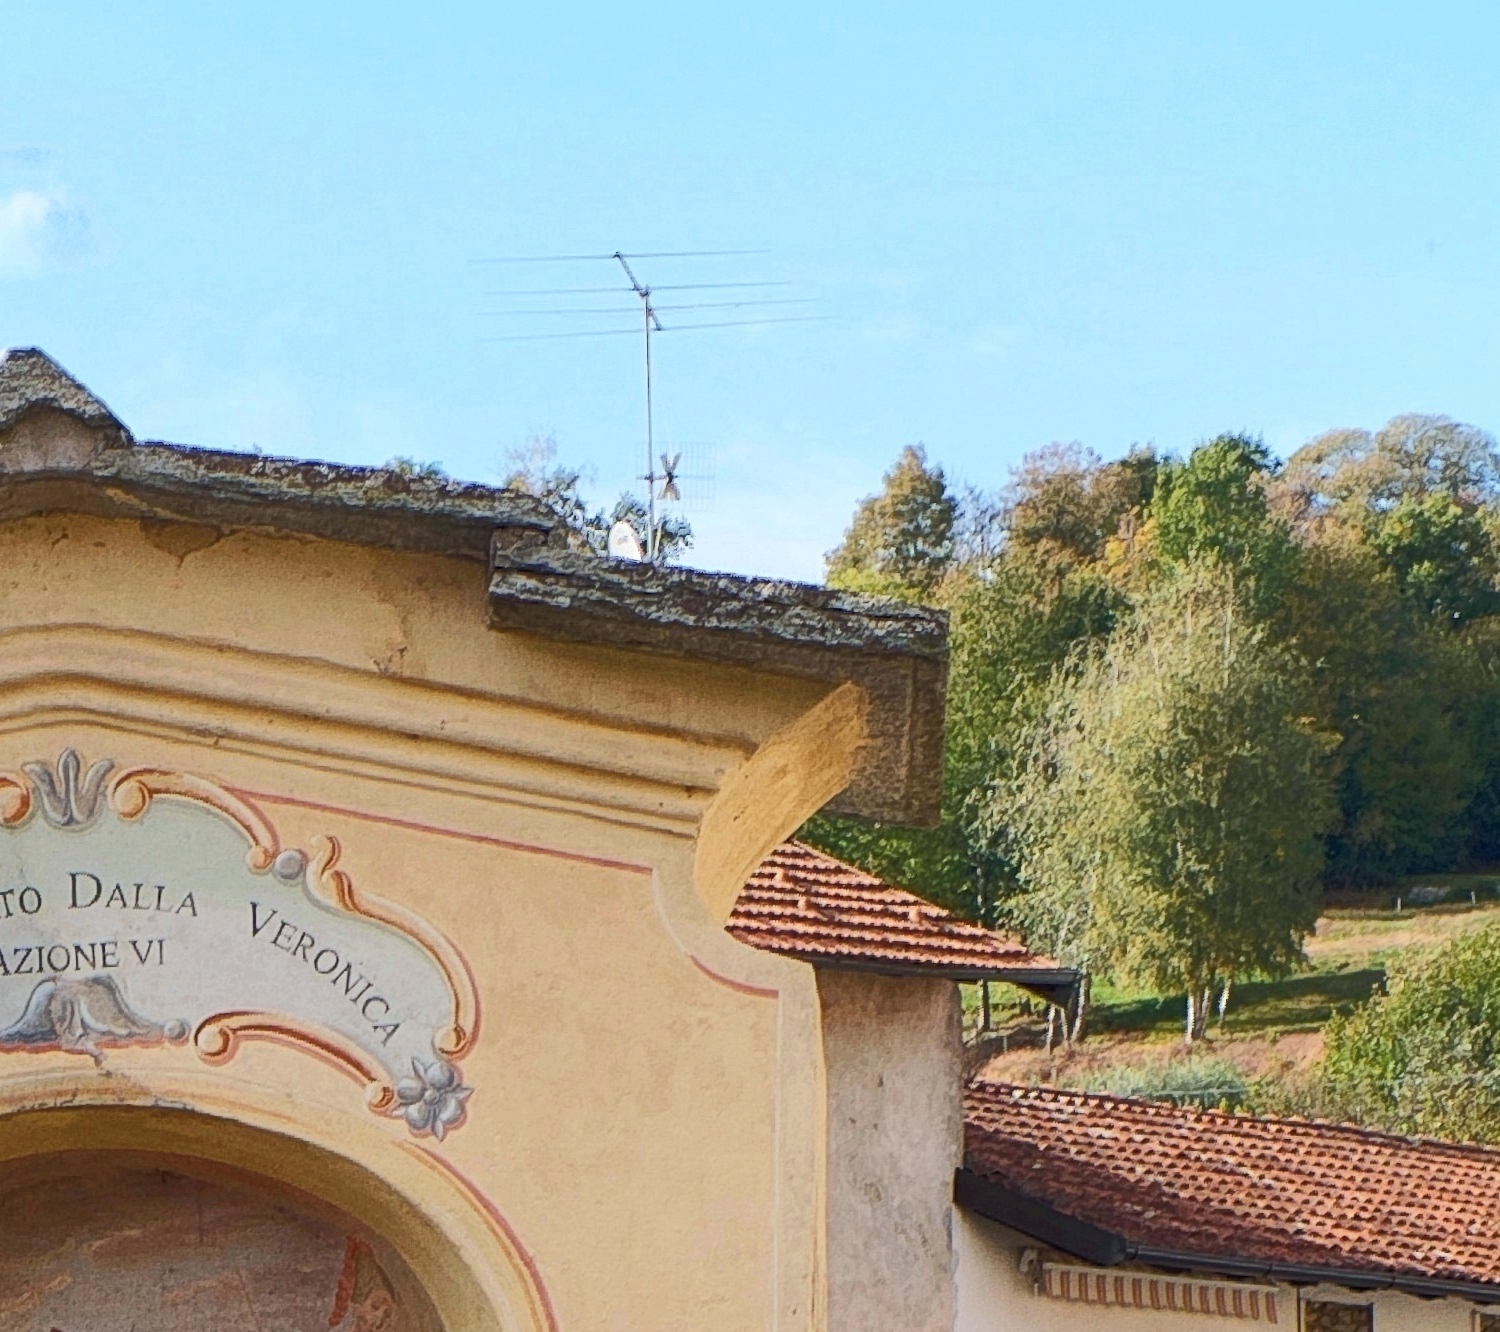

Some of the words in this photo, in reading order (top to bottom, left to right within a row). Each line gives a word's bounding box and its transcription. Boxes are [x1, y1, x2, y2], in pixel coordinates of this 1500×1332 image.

[67, 871, 198, 917] DALLA
[249, 900, 402, 1048] VERONICA
[128, 938, 166, 968] VI
